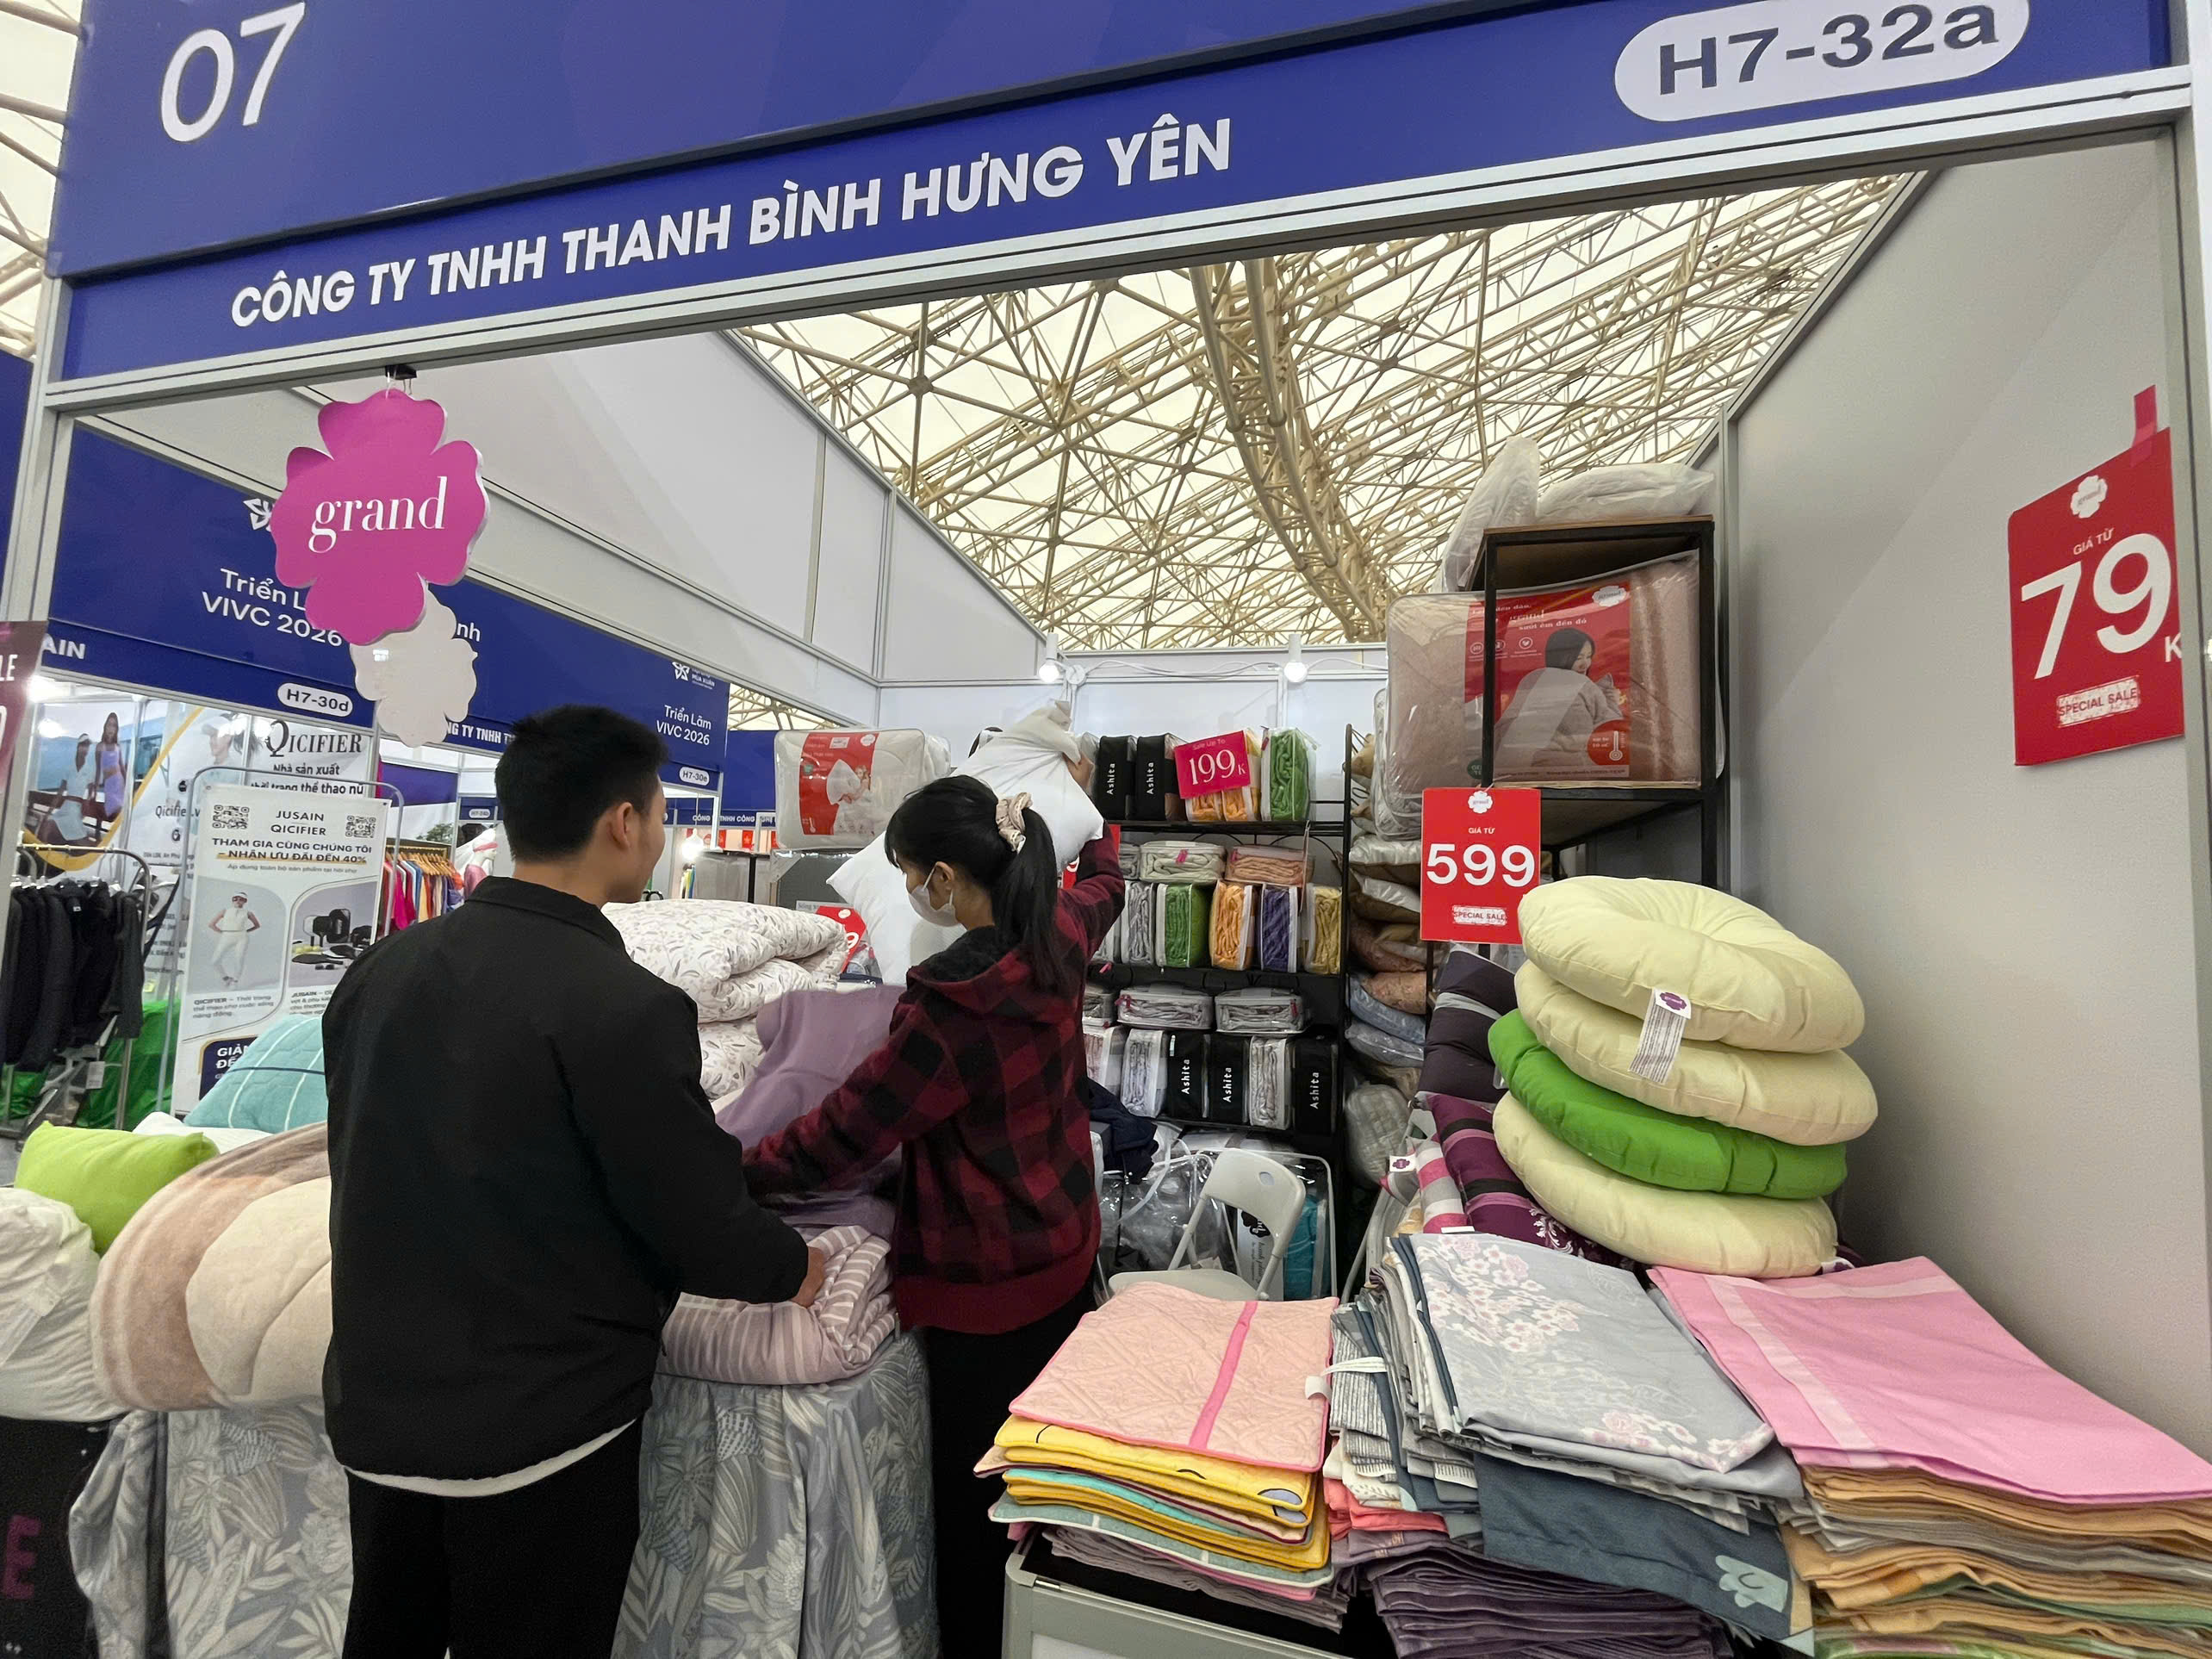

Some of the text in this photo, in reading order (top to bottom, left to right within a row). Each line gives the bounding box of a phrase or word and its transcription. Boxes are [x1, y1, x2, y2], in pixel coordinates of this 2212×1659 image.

[1660, 4, 1998, 95] H7-32a
[161, 2, 305, 142] 07
[232, 113, 1230, 327] CÔNG TY TNHH THANH BÌNH HƯNG YÊN
[308, 476, 448, 553] grand
[2073, 527, 2116, 555] GIÁ TỪ
[220, 568, 287, 605] Triển
[201, 591, 344, 648] VIVC 2026
[286, 688, 349, 712] H7-30d
[2059, 687, 2139, 718] SPECIAL SALE
[663, 705, 711, 730] Triển Lãm
[265, 720, 362, 757] QICIFIER
[462, 724, 474, 738] TY
[475, 727, 501, 743] TNHH
[656, 719, 710, 746] VIVC 2026
[295, 762, 314, 775] sản
[315, 763, 339, 775] xuất
[682, 771, 708, 782] H7-30e
[1106, 763, 1115, 795] Ashita
[301, 780, 319, 792] thể
[321, 782, 345, 794] thao
[270, 824, 326, 836] QICIFIER
[276, 811, 324, 822] JUSAIN
[1468, 826, 1482, 835] GIÁ
[212, 837, 249, 847] THAM
[276, 839, 310, 850] CÙNG
[313, 842, 352, 853] CHÚNG
[356, 844, 372, 854] TÔI
[1426, 843, 1535, 887] 599
[1453, 910, 1506, 921] SPECIAL SALE
[1181, 1058, 1190, 1095] Ashita
[1222, 1066, 1233, 1103] Ashita
[1309, 1072, 1320, 1109] Ashita
